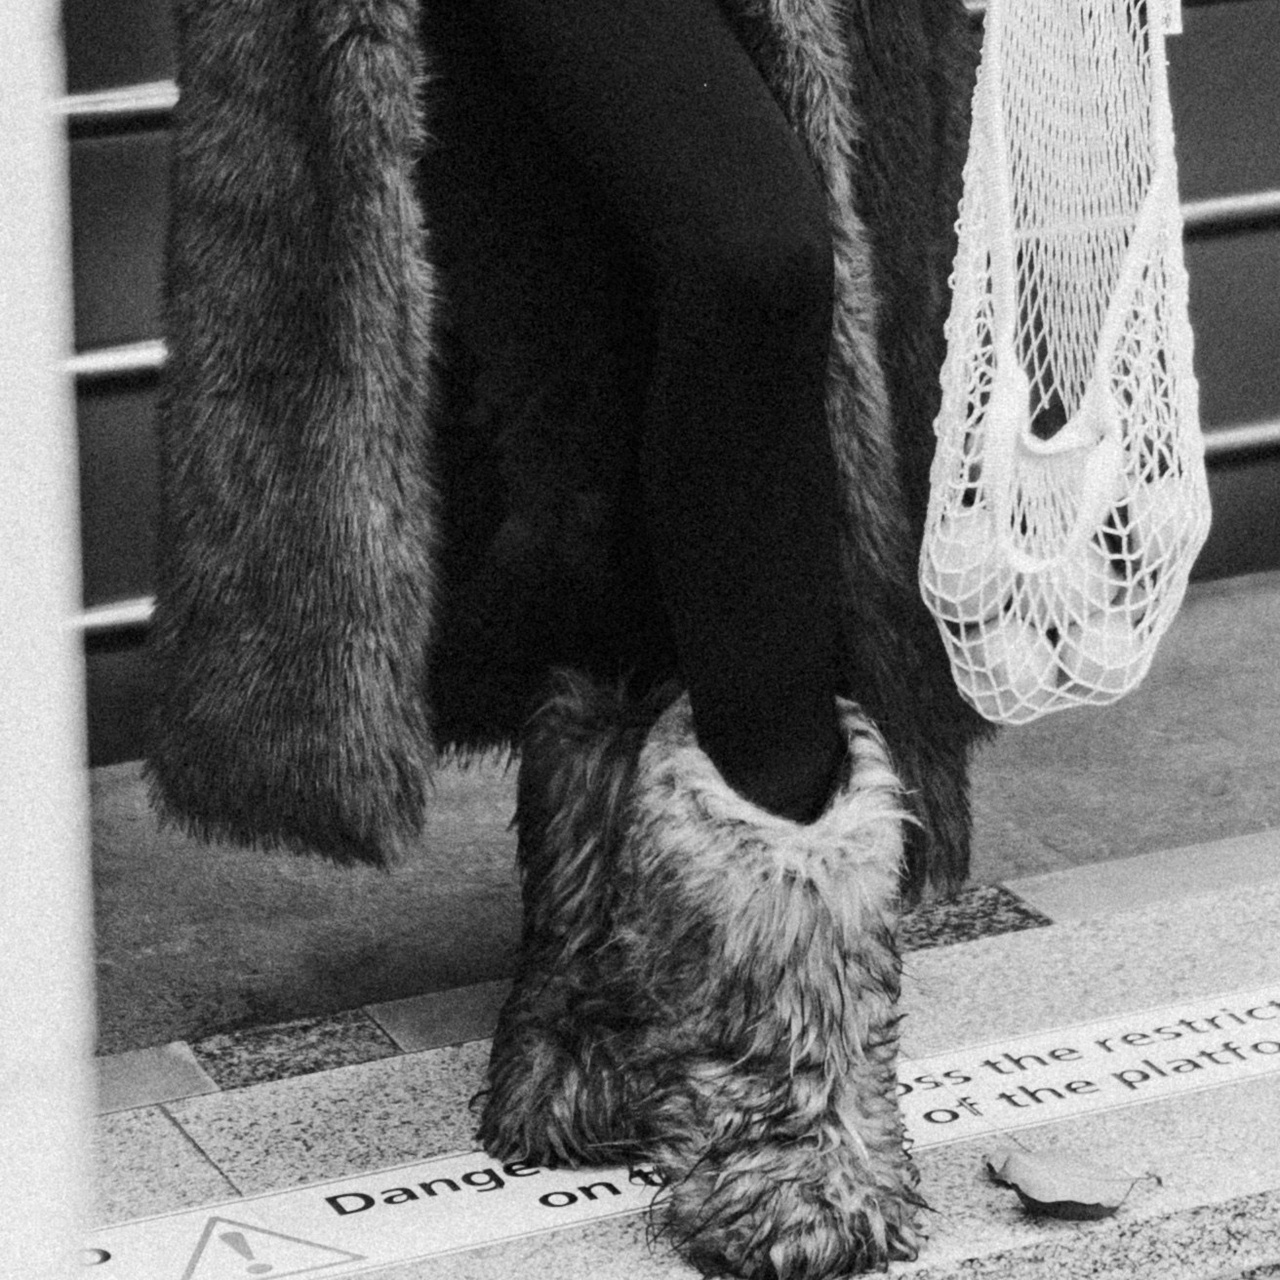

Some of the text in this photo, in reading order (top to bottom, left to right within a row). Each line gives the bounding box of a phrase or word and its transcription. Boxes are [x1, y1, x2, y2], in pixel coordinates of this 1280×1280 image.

[325, 1159, 541, 1216] Dange
[979, 1047, 1084, 1075] the
[538, 1181, 622, 1207] on
[922, 1096, 983, 1124] of
[996, 1080, 1100, 1108] the
